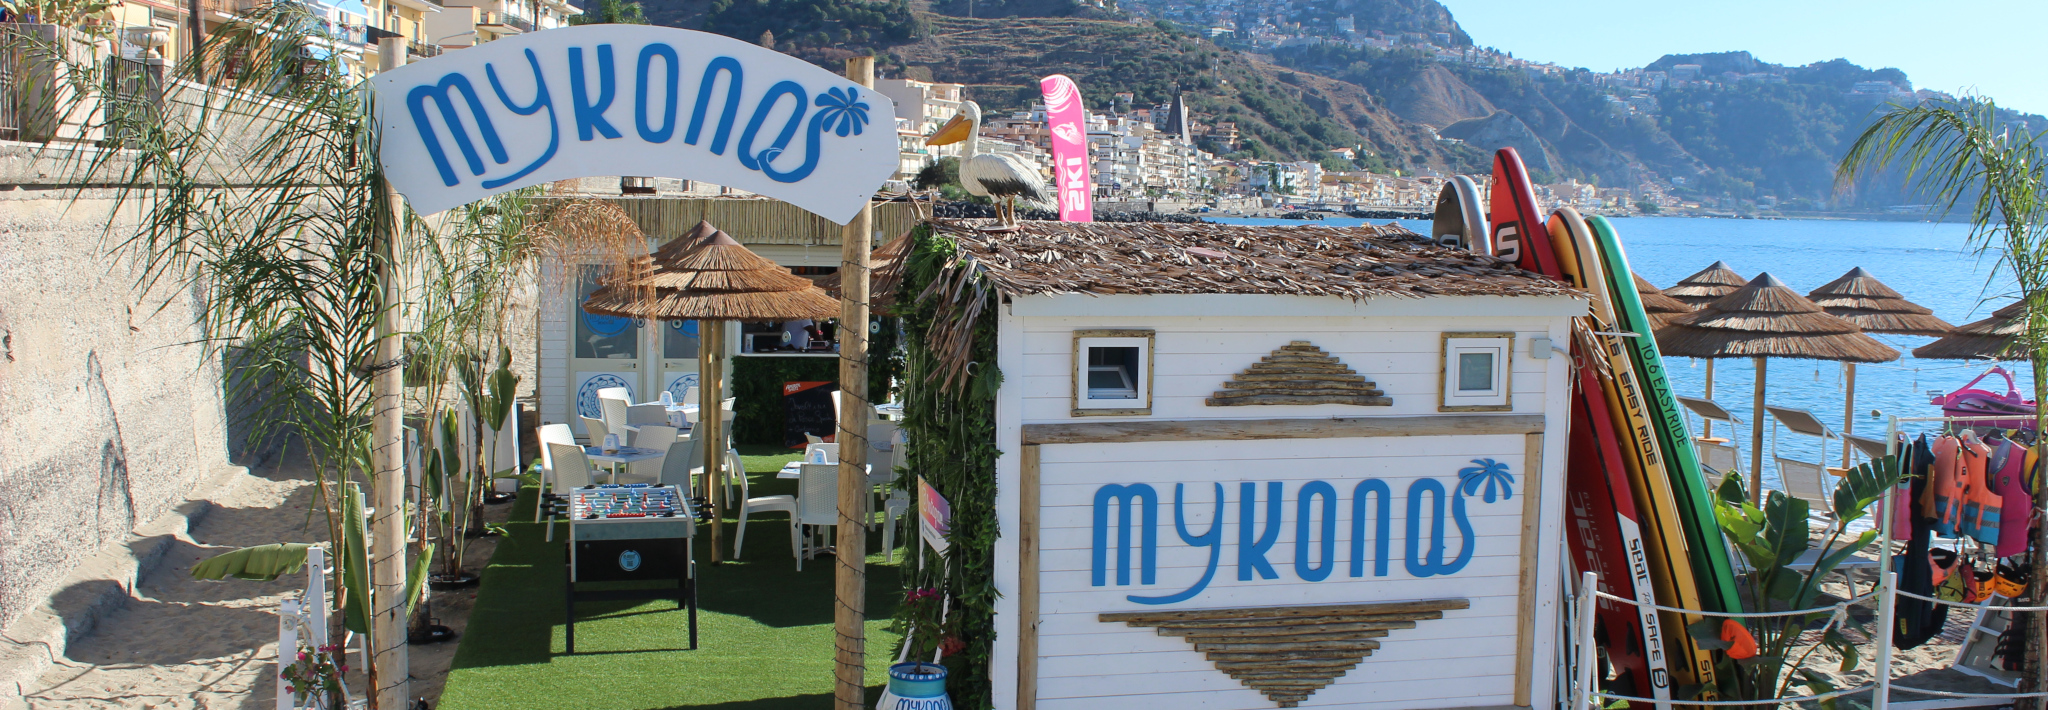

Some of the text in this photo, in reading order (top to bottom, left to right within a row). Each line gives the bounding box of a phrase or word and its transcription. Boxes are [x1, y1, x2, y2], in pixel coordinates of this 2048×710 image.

[406, 43, 868, 189] MYKONOS
[1641, 343, 1660, 374] 10.6
[1619, 371, 1643, 418] EASY
[1637, 426, 1658, 466] RIDE
[1092, 462, 1513, 605] MYKONOS
[1645, 613, 1662, 662] SAFE
[1700, 659, 1718, 706] SAE
